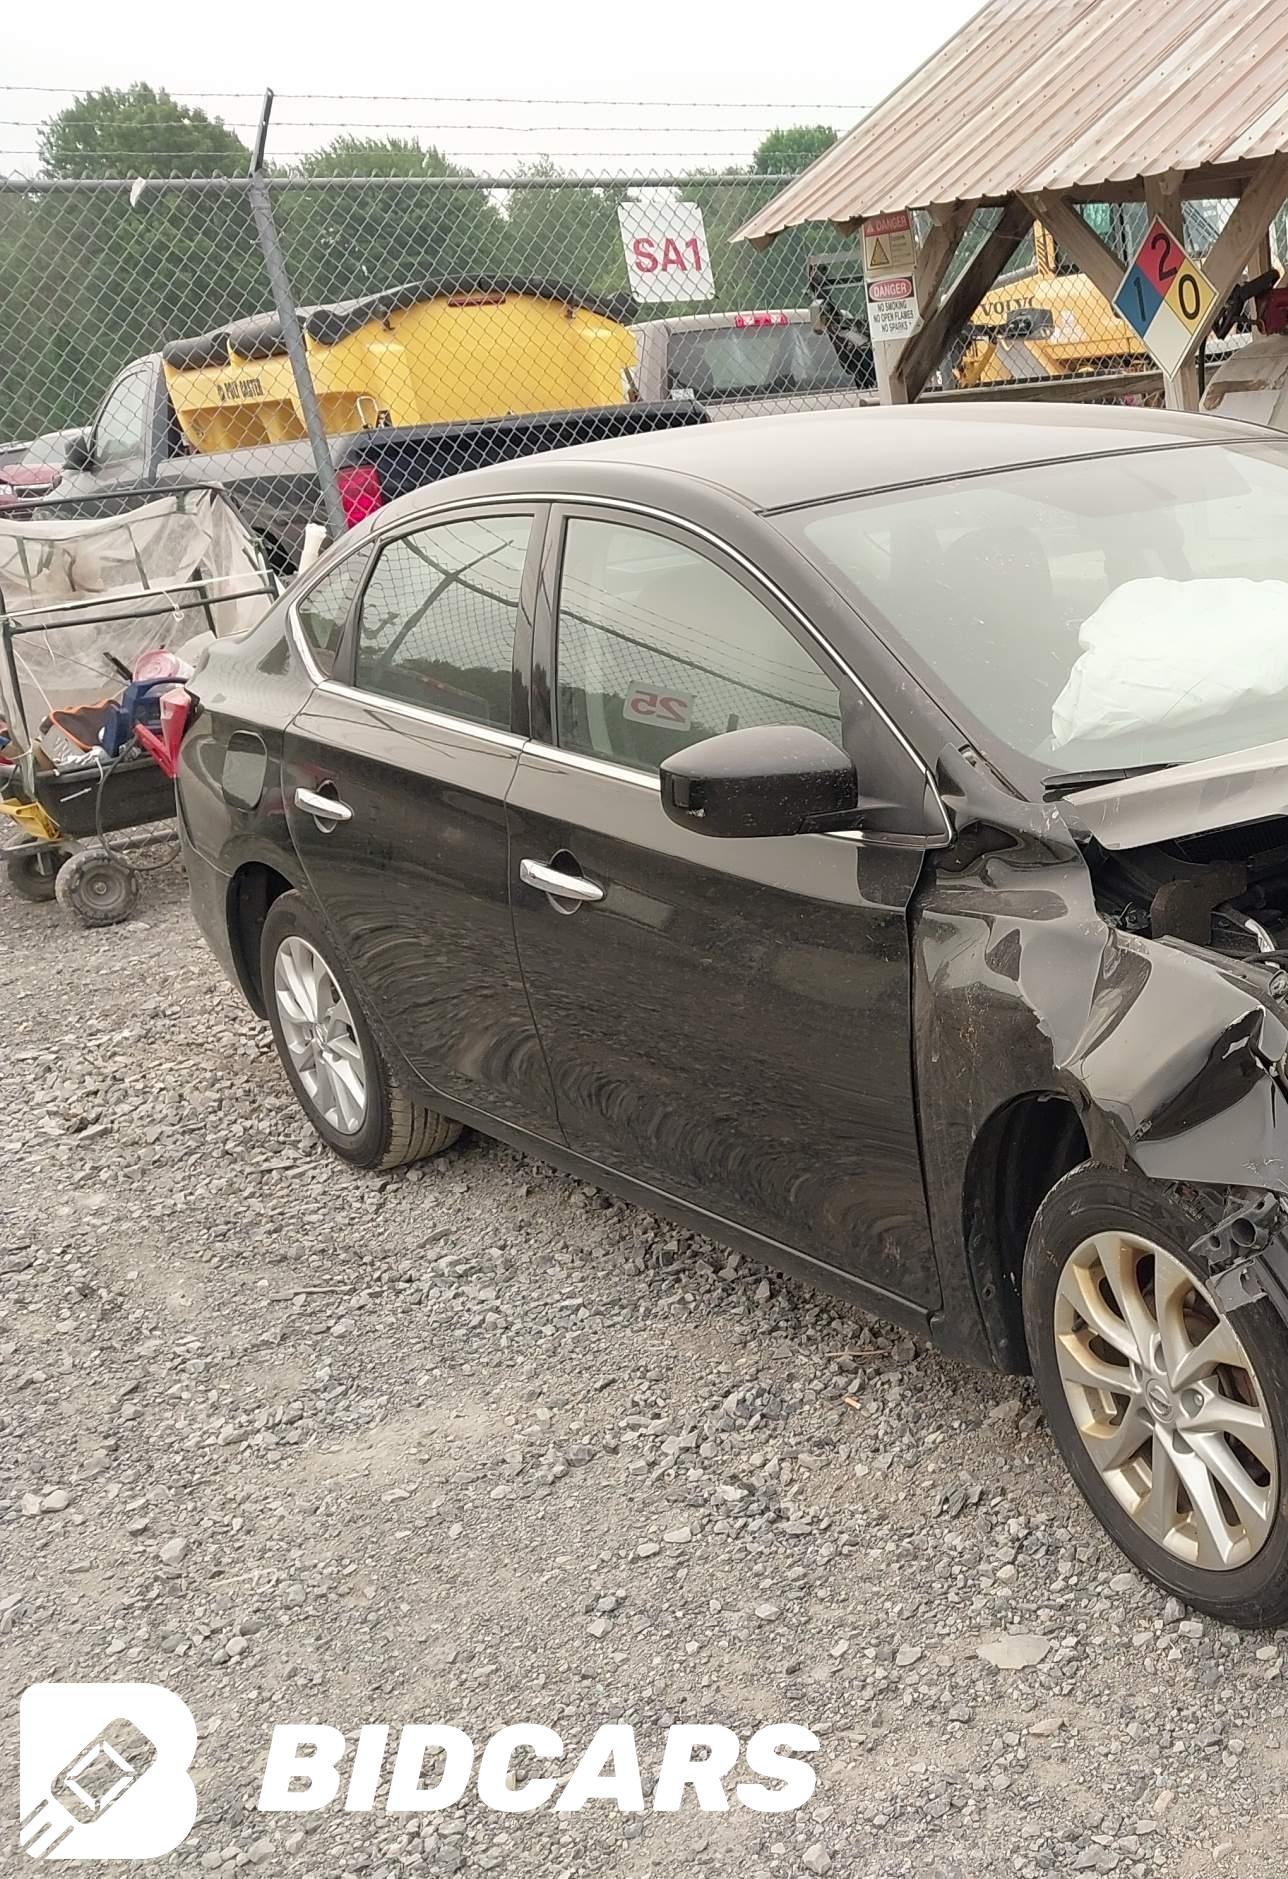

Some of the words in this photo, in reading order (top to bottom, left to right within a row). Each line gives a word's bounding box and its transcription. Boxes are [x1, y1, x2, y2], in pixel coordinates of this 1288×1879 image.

[875, 215, 907, 231] DANGER
[633, 237, 702, 273] SA1
[1151, 233, 1178, 281] 2
[873, 282, 908, 298] DANGER
[1178, 273, 1201, 321] 0
[877, 303, 884, 313] NO
[885, 300, 908, 311] SMOKING
[1133, 277, 1146, 322] 1
[873, 313, 881, 323] NO
[881, 311, 894, 322] OPEN
[895, 309, 914, 320] FLAMES
[881, 323, 889, 333] NO
[889, 321, 908, 332] SPARKS
